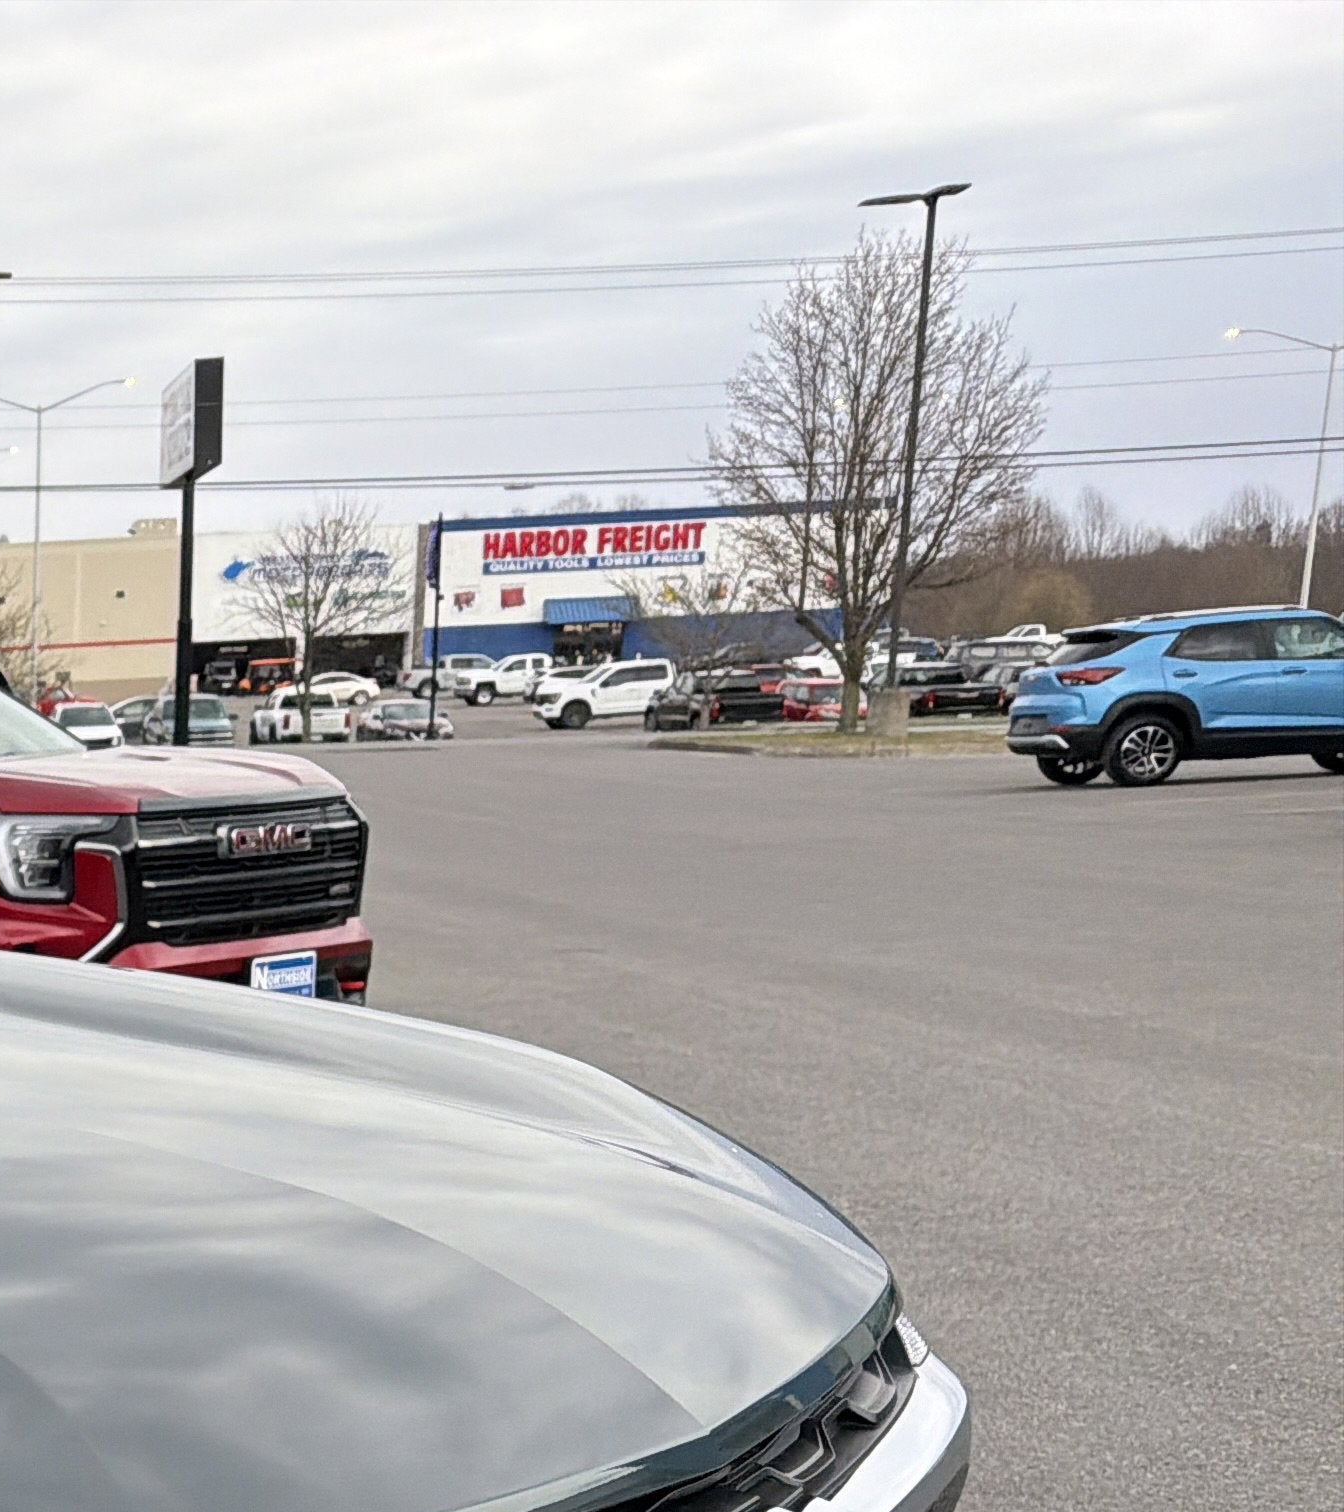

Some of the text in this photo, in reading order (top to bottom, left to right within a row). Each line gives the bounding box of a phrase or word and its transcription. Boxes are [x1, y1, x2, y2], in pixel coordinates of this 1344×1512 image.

[482, 522, 707, 560] HARBOR FREIGHT
[489, 560, 544, 572] QUALITY
[548, 558, 590, 570] TOOLS
[596, 554, 648, 567] LOWEST
[230, 823, 312, 859] GMC
